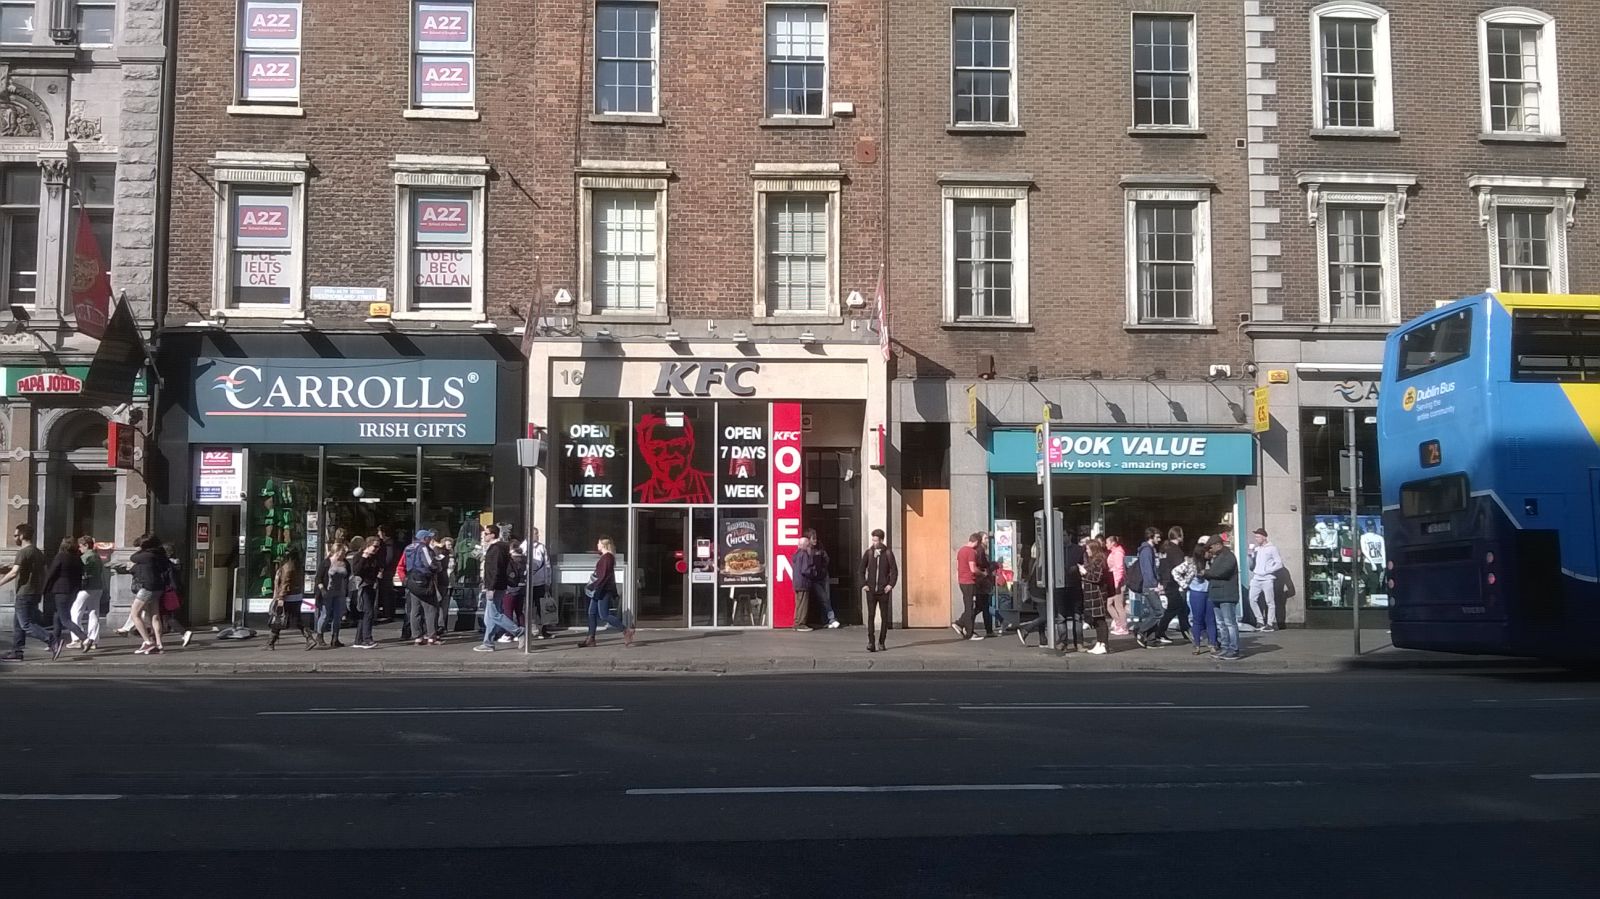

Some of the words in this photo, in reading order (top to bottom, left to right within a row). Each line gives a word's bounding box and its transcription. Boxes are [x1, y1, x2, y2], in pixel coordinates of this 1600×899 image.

[252, 13, 291, 27] A2Z
[423, 16, 462, 30] A2Z
[251, 63, 290, 77] A2Z
[425, 67, 464, 81] A2Z
[243, 211, 282, 225] A2Z
[423, 207, 462, 222] A2Z
[244, 261, 282, 273] IELTS
[429, 262, 457, 274] BEC
[249, 274, 277, 286] CAE
[415, 274, 470, 286] CALLAN
[18, 375, 46, 392] PAPA
[560, 369, 583, 385] 16
[652, 361, 760, 396] KFC
[224, 365, 465, 409] CARROLLS
[1416, 385, 1440, 402] Dublin
[1440, 381, 1456, 395] Bus
[359, 423, 410, 438] IRISH
[414, 423, 467, 438] GIFTS
[569, 424, 610, 438] OPEN
[724, 427, 762, 440] OPEN
[773, 431, 801, 441] KFC
[565, 445, 573, 458] 7
[577, 444, 616, 458] DAYS
[720, 446, 728, 459] 7
[731, 446, 766, 459] DAYS
[1060, 436, 1113, 455] OOK
[1121, 437, 1207, 456] VALUE
[584, 465, 595, 478] A
[737, 465, 748, 478] A
[1077, 460, 1112, 469] books
[1121, 461, 1168, 471] amazing
[1171, 461, 1207, 472] prices
[570, 484, 613, 498] WEEK
[725, 485, 764, 498] WEEK
